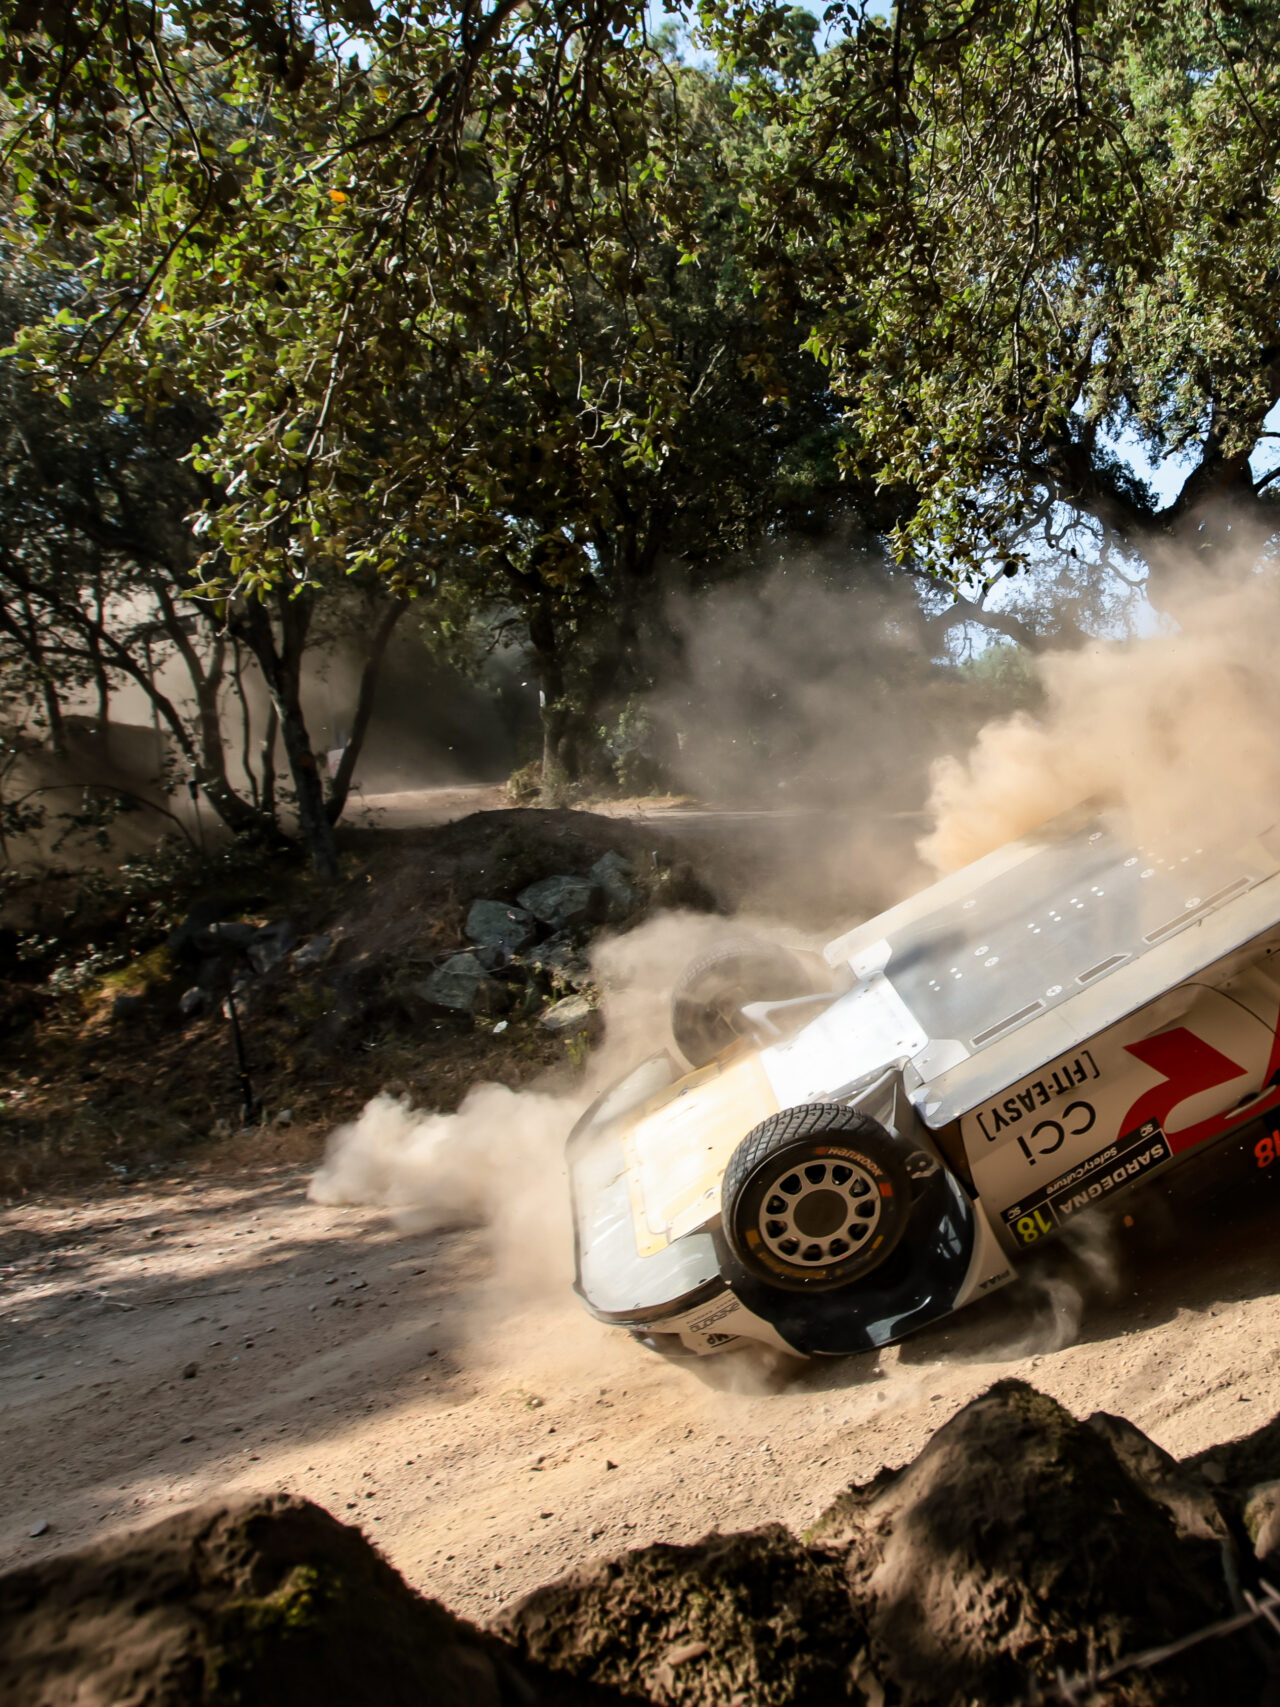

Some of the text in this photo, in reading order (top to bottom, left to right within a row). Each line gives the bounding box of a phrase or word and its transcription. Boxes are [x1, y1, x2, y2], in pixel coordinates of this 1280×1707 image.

[1045, 1145, 1119, 1196] SafetyCulture
[1059, 1142, 1165, 1216] SARDEGNA
[1016, 1208, 1054, 1245] 18
